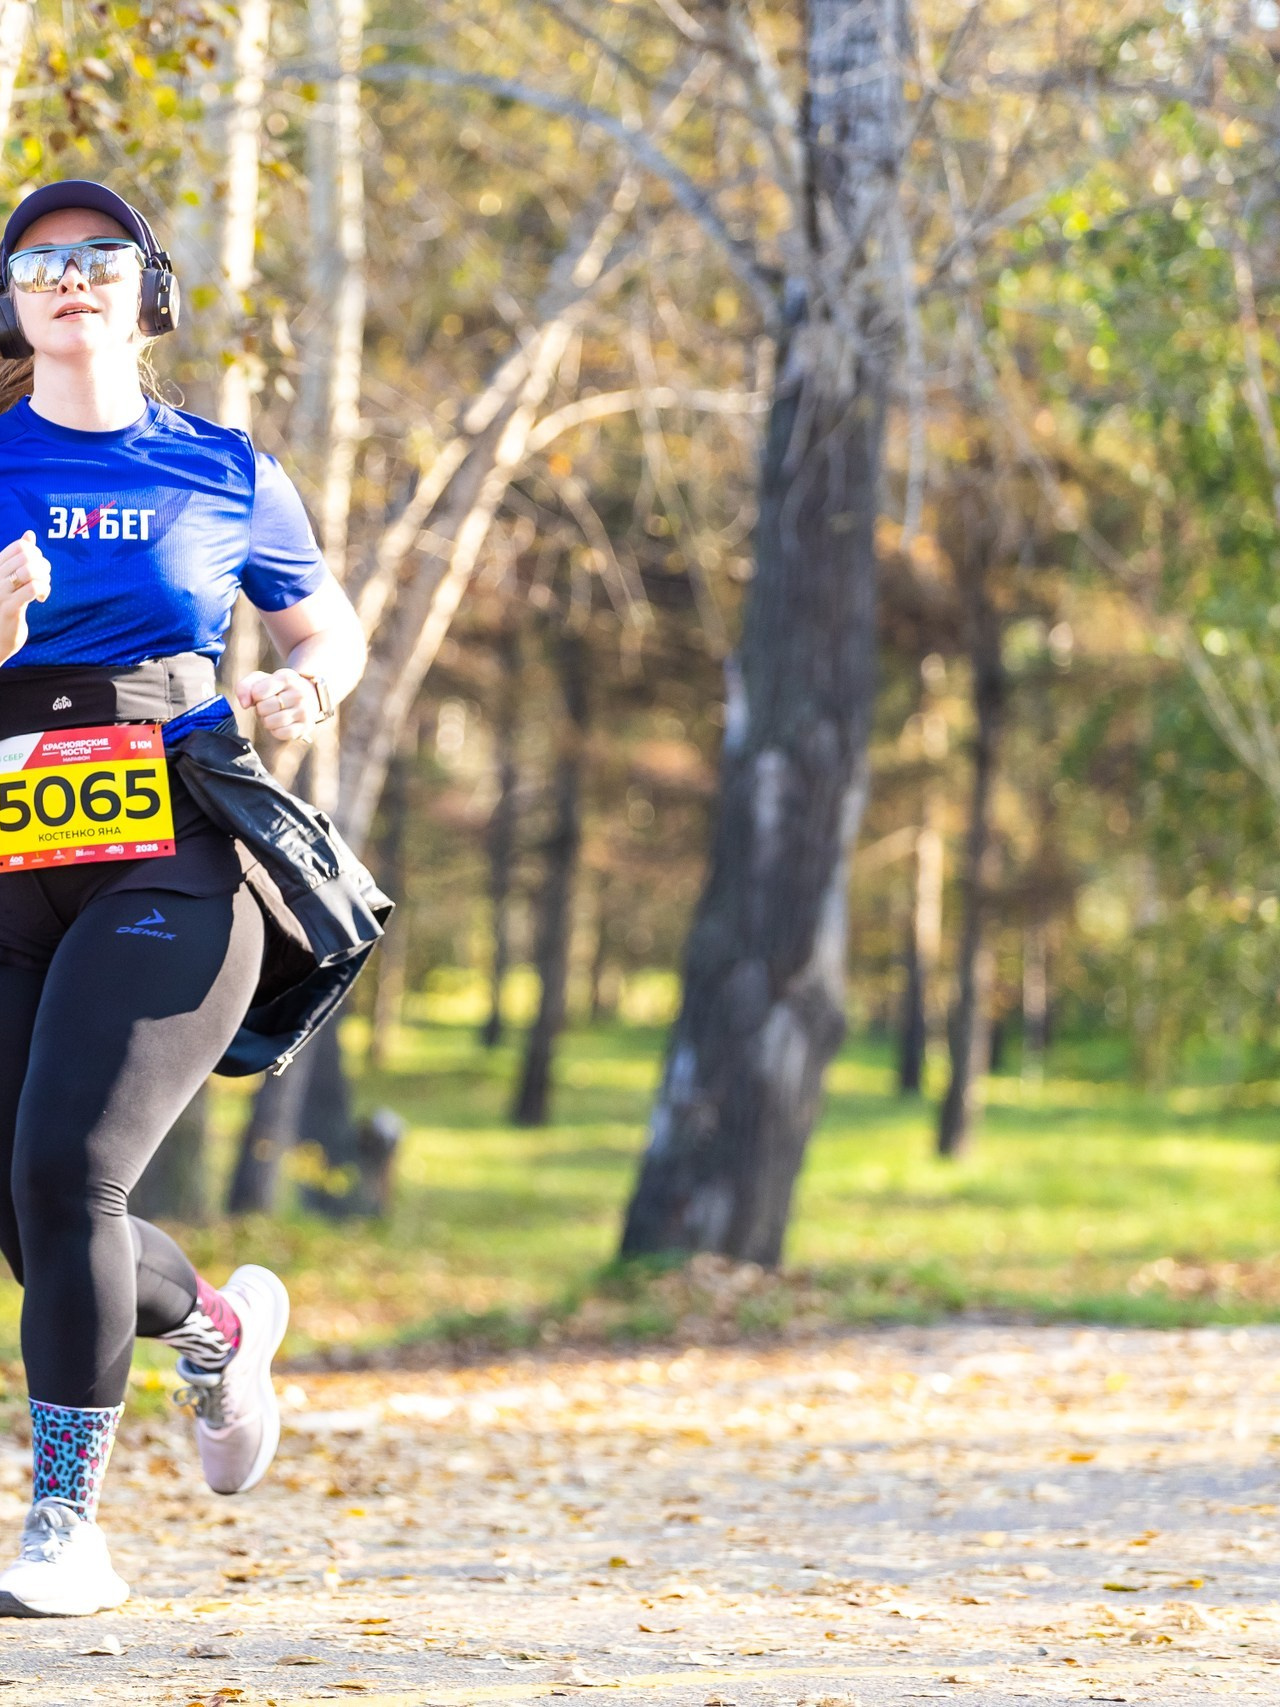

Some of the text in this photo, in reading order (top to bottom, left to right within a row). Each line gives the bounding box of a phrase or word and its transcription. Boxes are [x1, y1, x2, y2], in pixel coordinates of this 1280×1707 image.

[42, 738, 109, 751] КРАСНОЯРСКИЕ
[130, 740, 152, 750] 5 КМ
[3, 752, 24, 762] СБЕР
[60, 747, 92, 757] МОСТЫ
[38, 826, 121, 842] КОСТЕНКО ЯНА
[115, 926, 177, 941] DEMIX
